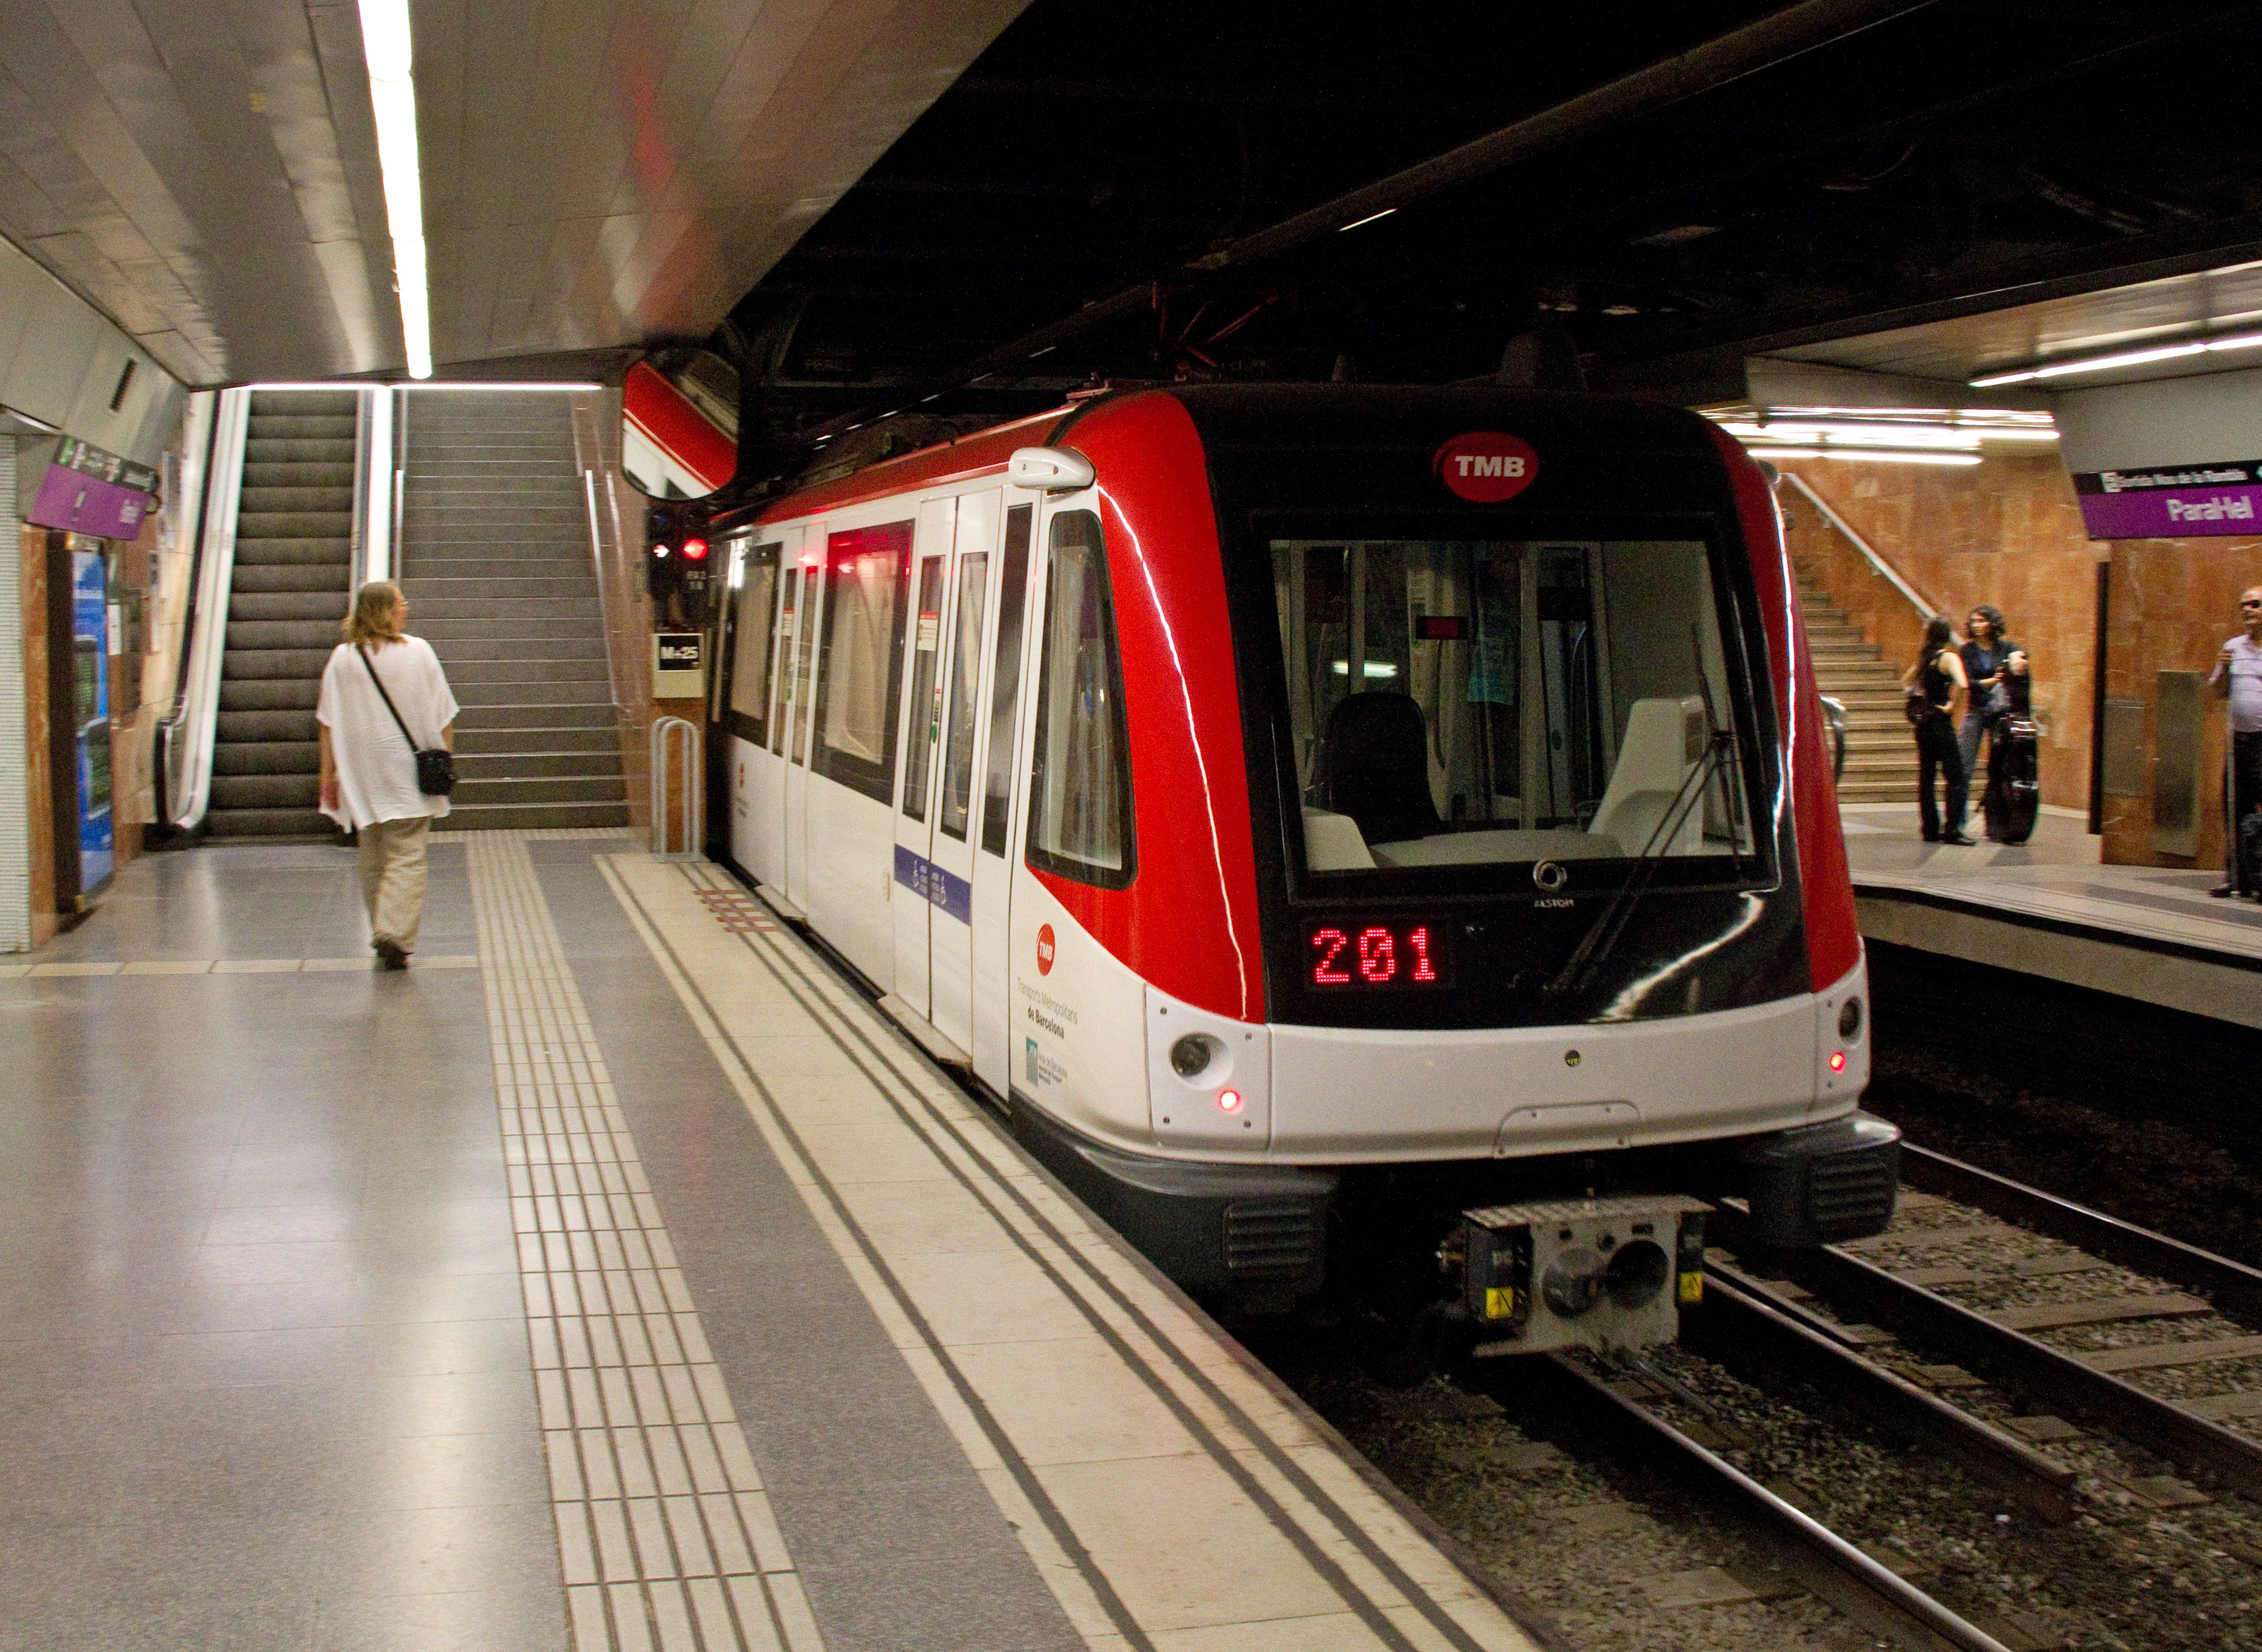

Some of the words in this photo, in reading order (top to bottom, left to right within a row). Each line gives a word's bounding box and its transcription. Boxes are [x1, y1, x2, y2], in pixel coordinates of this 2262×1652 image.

[1455, 455, 1526, 477] TMB
[1039, 941, 1052, 961] TMB
[1313, 928, 1435, 983] 201
[1028, 1005, 1035, 1021] de
[1035, 1009, 1064, 1039] Barcelona
